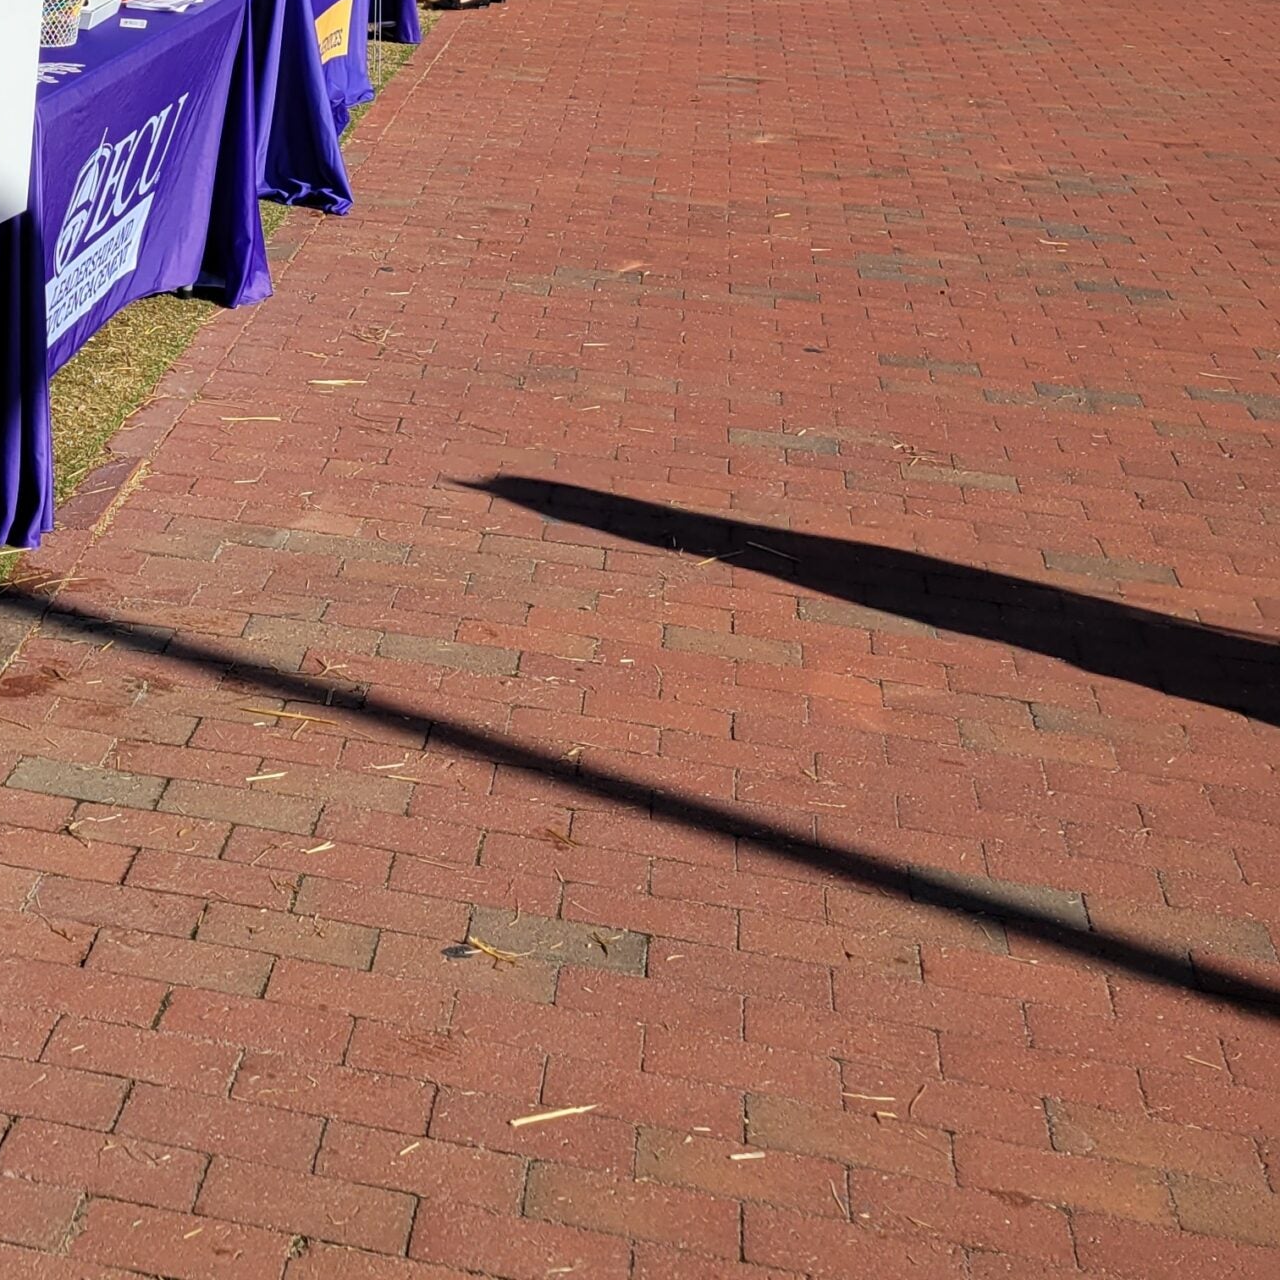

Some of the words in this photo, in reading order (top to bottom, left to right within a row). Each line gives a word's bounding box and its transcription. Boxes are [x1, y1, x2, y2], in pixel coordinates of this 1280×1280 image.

[84, 92, 189, 242] ECU
[49, 237, 116, 311] LEADERSHIP
[111, 219, 134, 255] AND
[64, 240, 133, 321] ENGAGEMENT
